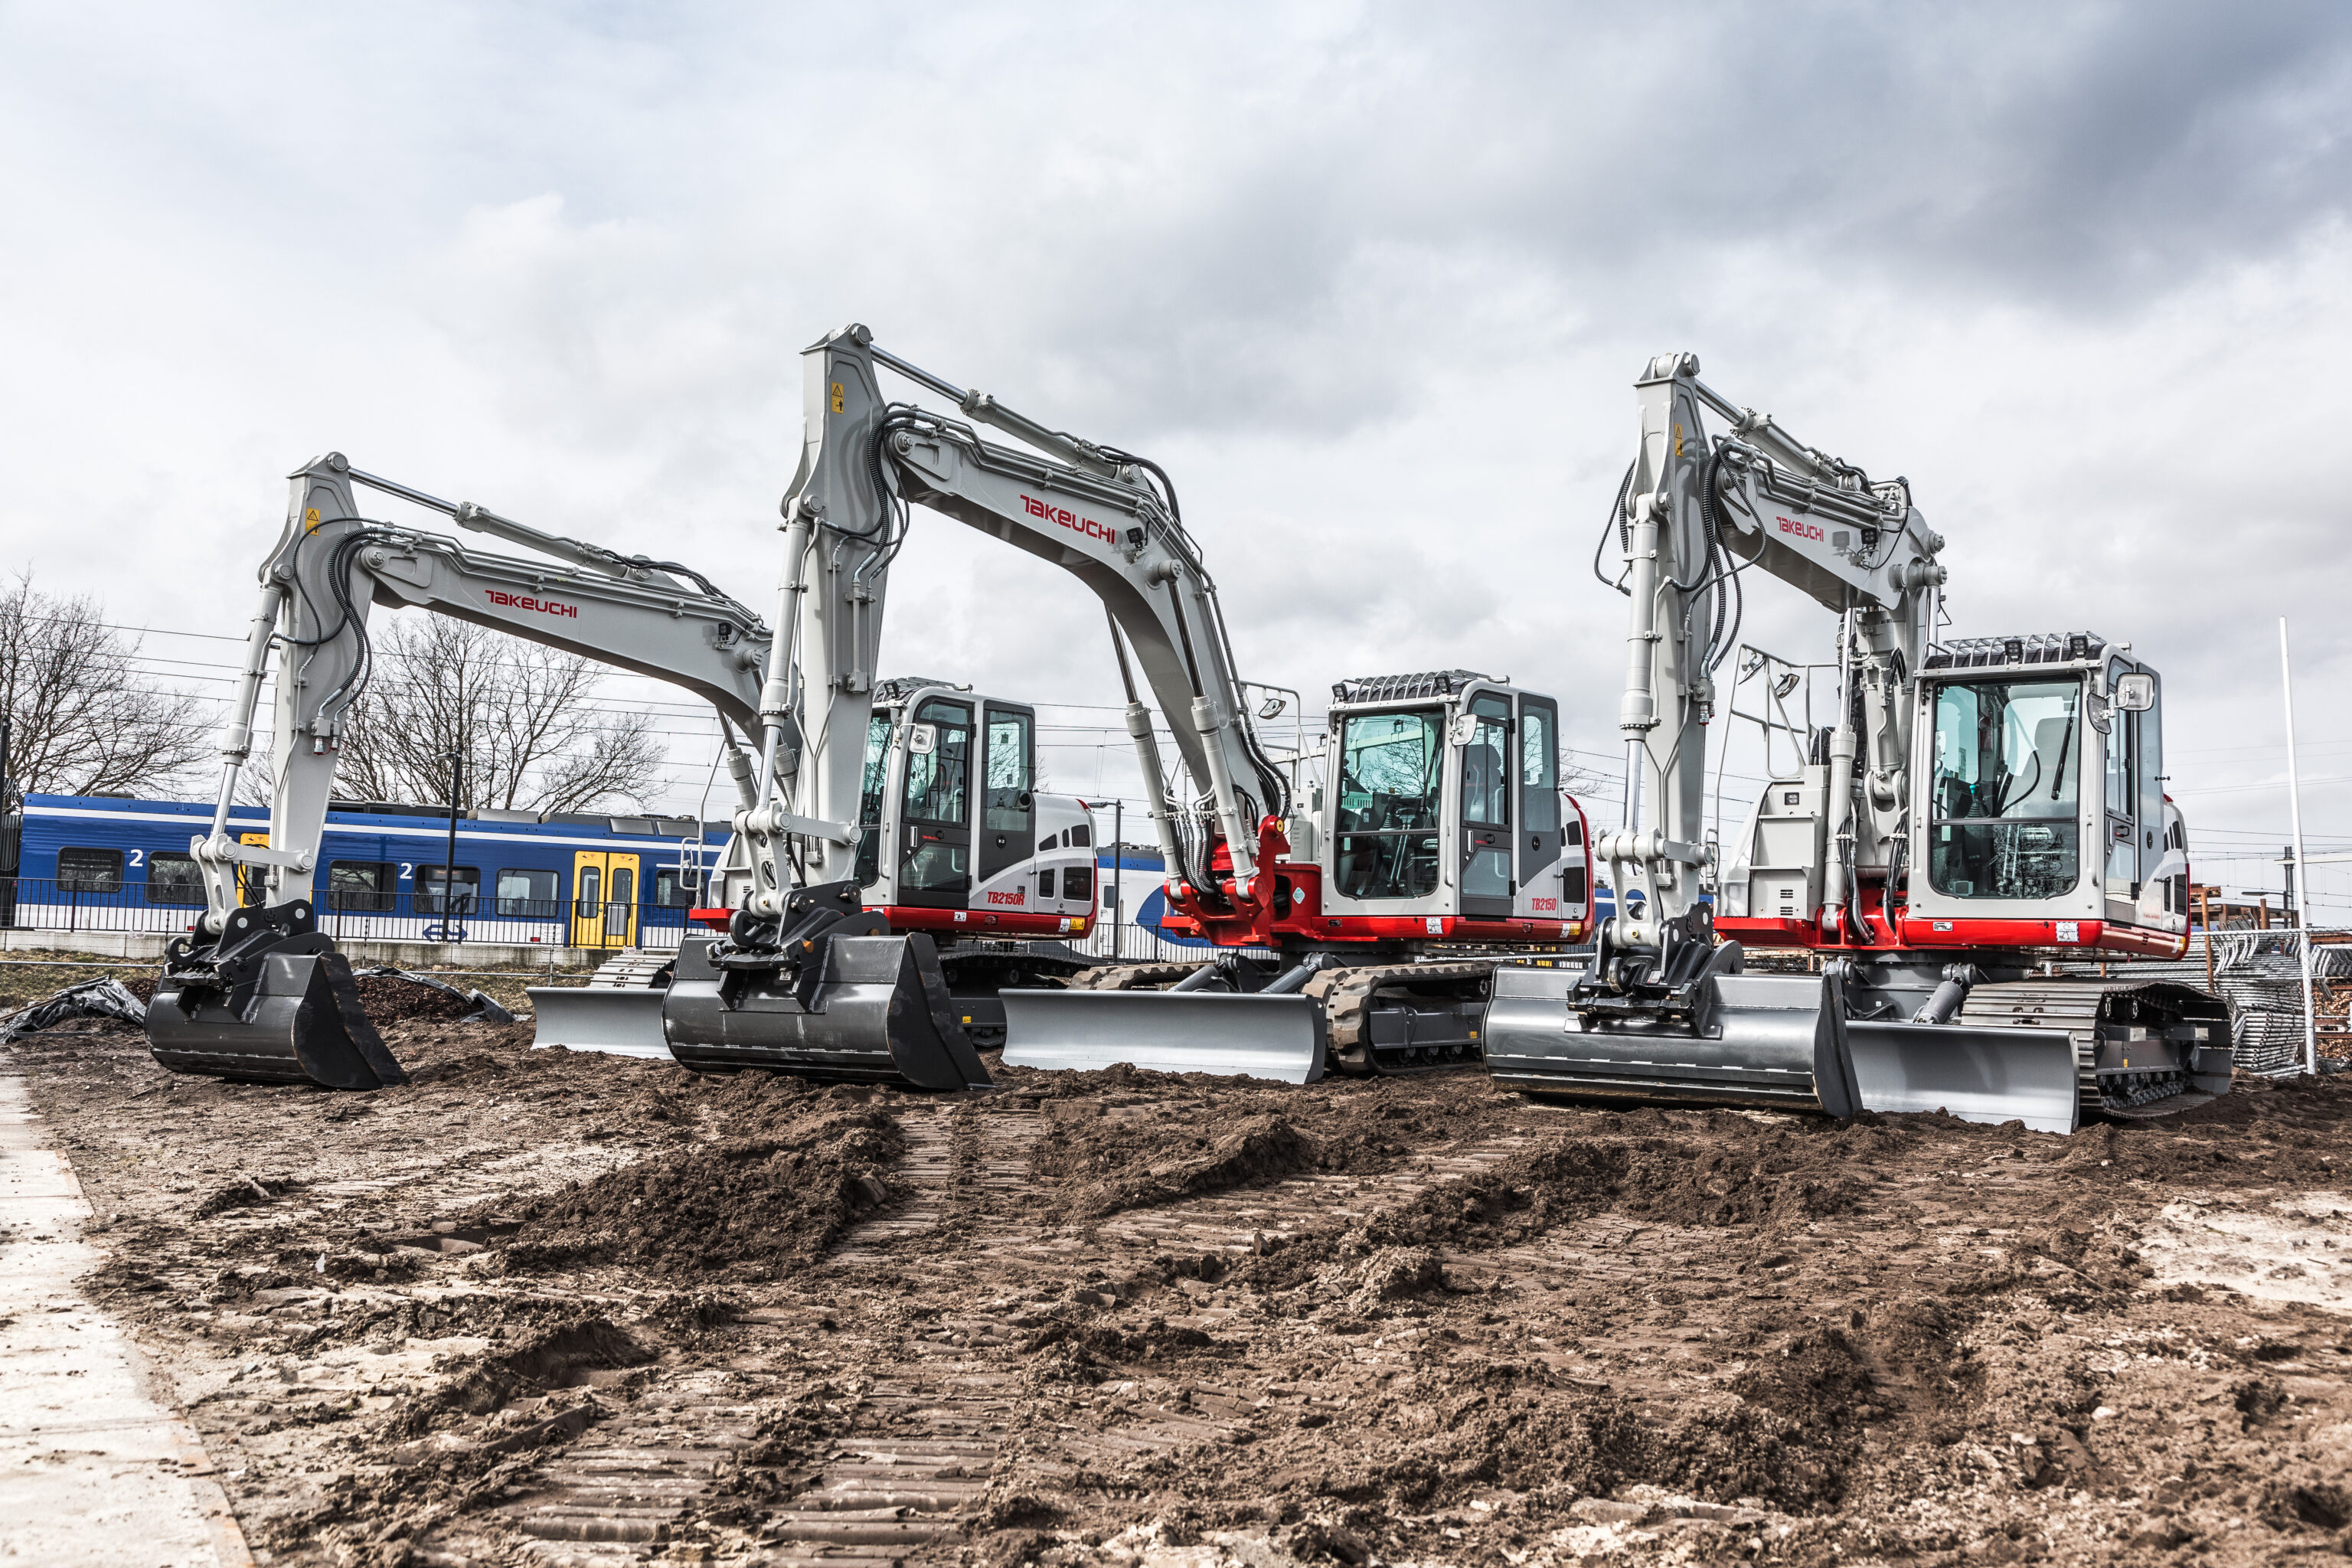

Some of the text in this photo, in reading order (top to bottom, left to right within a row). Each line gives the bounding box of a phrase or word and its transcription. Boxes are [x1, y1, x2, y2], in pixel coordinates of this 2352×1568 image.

[129, 849, 143, 867] 2
[400, 862, 413, 880] 2
[987, 891, 1025, 906] TB2150R
[1532, 897, 1557, 911] TB2150
